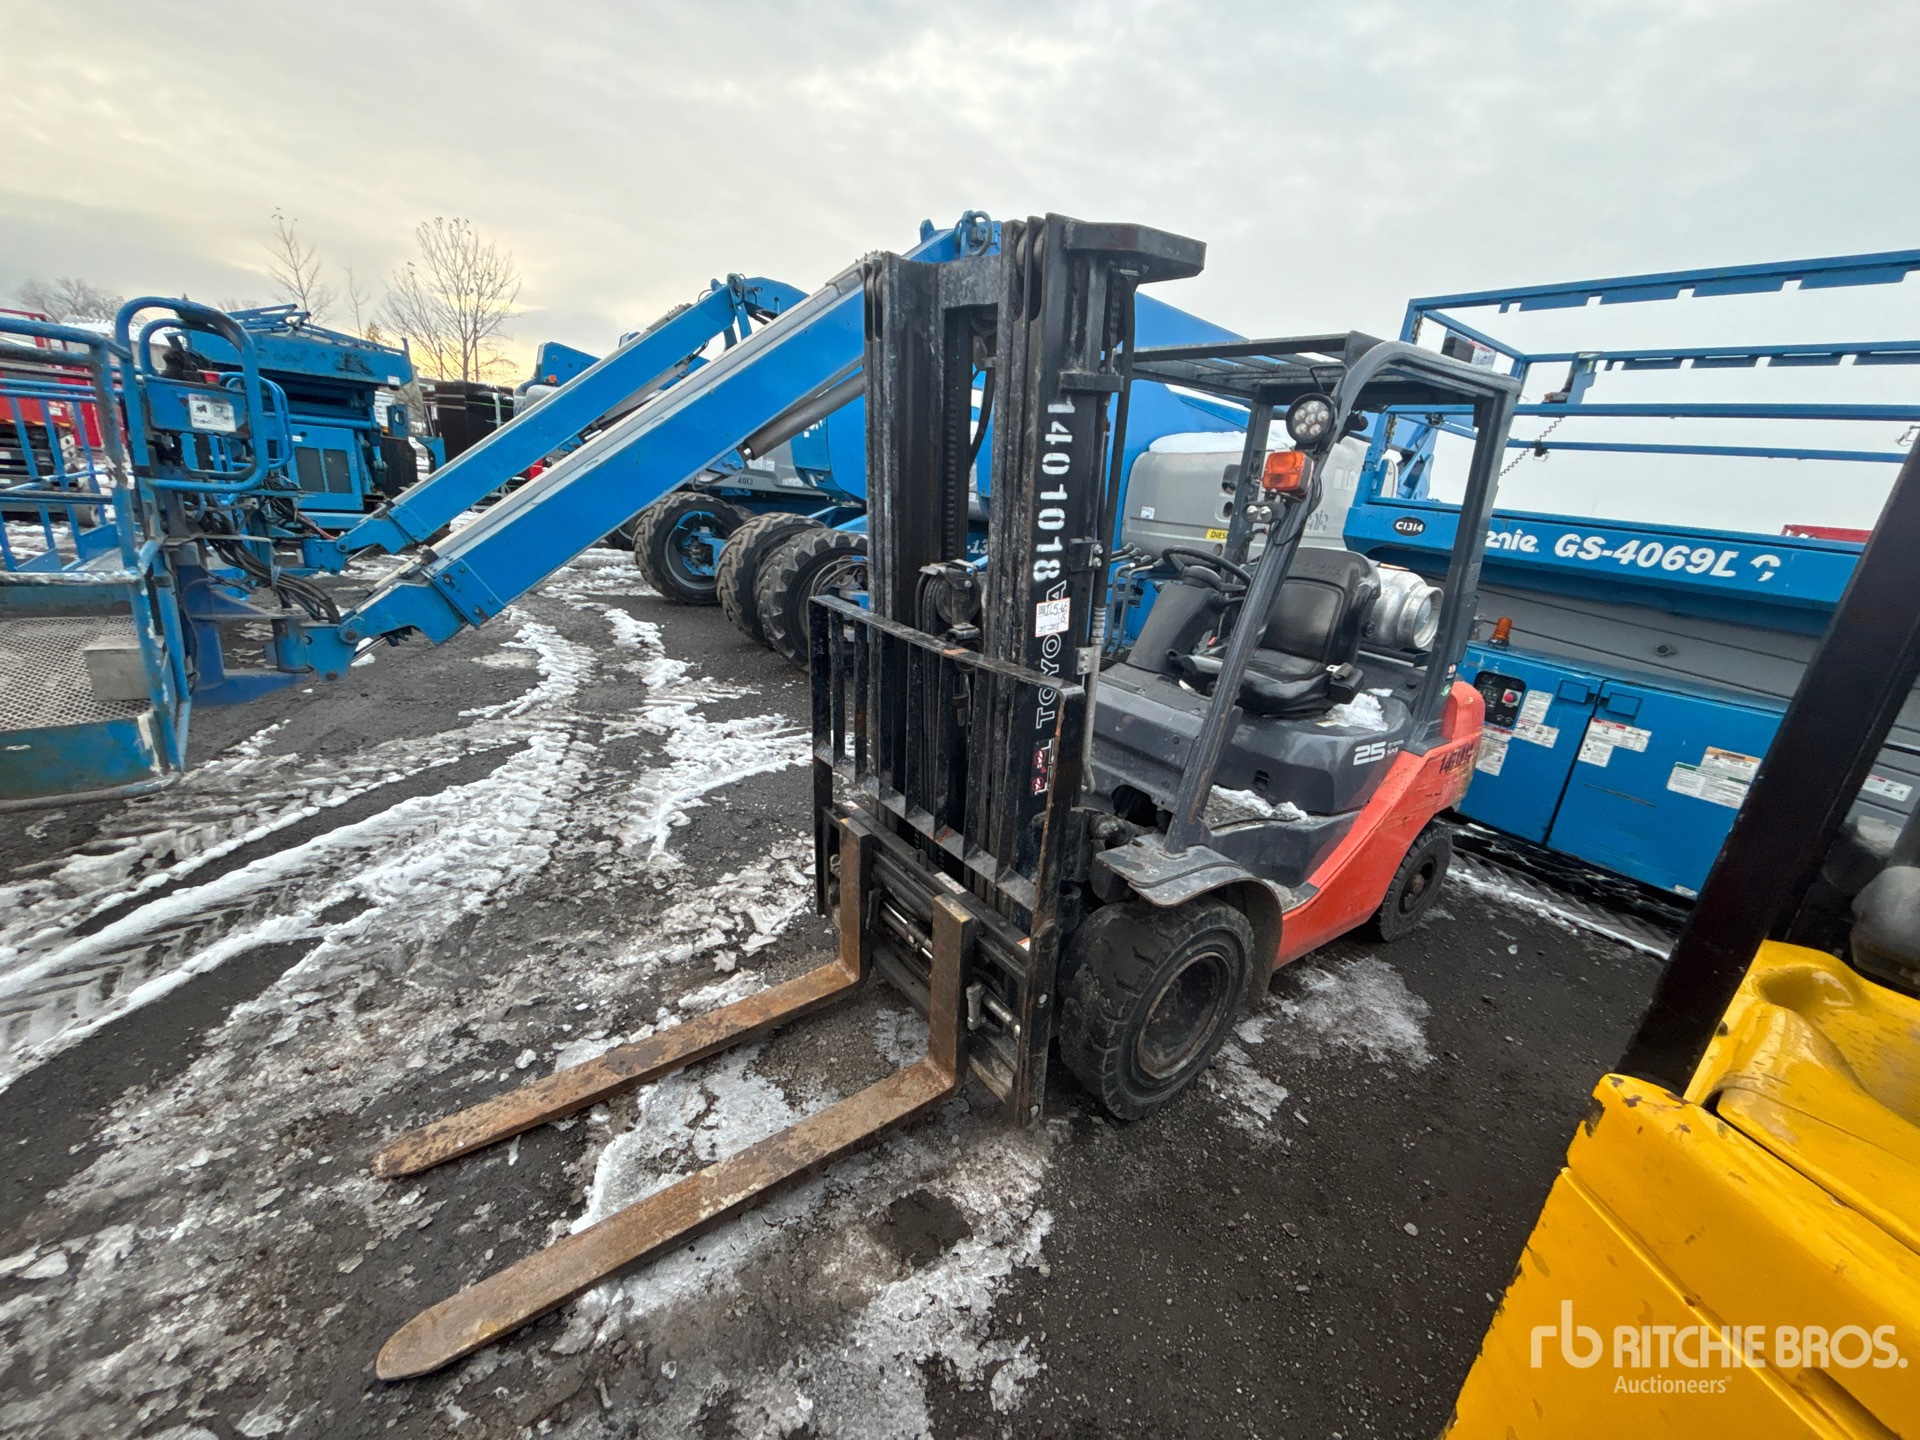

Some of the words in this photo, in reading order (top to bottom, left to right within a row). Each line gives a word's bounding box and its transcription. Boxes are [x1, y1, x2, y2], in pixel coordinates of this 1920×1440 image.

[1033, 395, 1075, 581] 1401018
[1210, 530, 1227, 540] DIES
[1395, 521, 1424, 532] C1314
[1485, 528, 1539, 553] enie
[1036, 580, 1067, 729] TOYOA
[1353, 741, 1387, 766] 25
